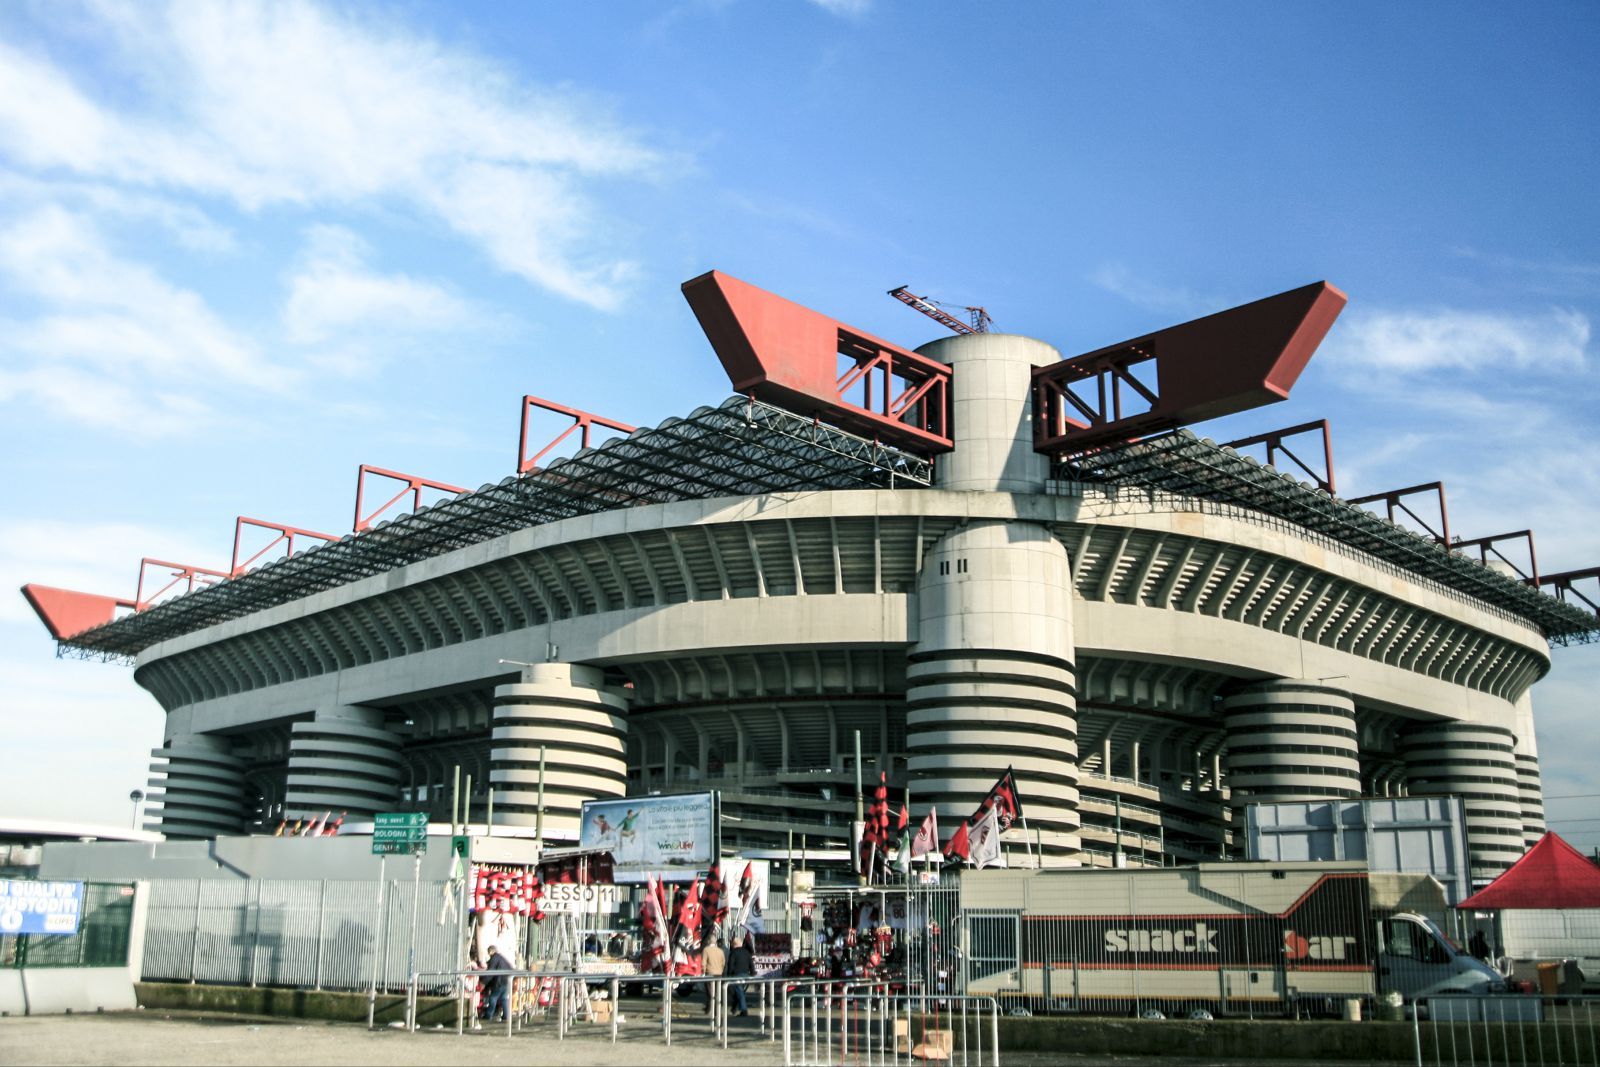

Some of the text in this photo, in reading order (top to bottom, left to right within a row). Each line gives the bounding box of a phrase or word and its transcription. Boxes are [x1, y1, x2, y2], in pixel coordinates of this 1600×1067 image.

[374, 830, 406, 838] BOLOGNA
[600, 888, 614, 902] 11
[1105, 922, 1356, 960] snack bar
